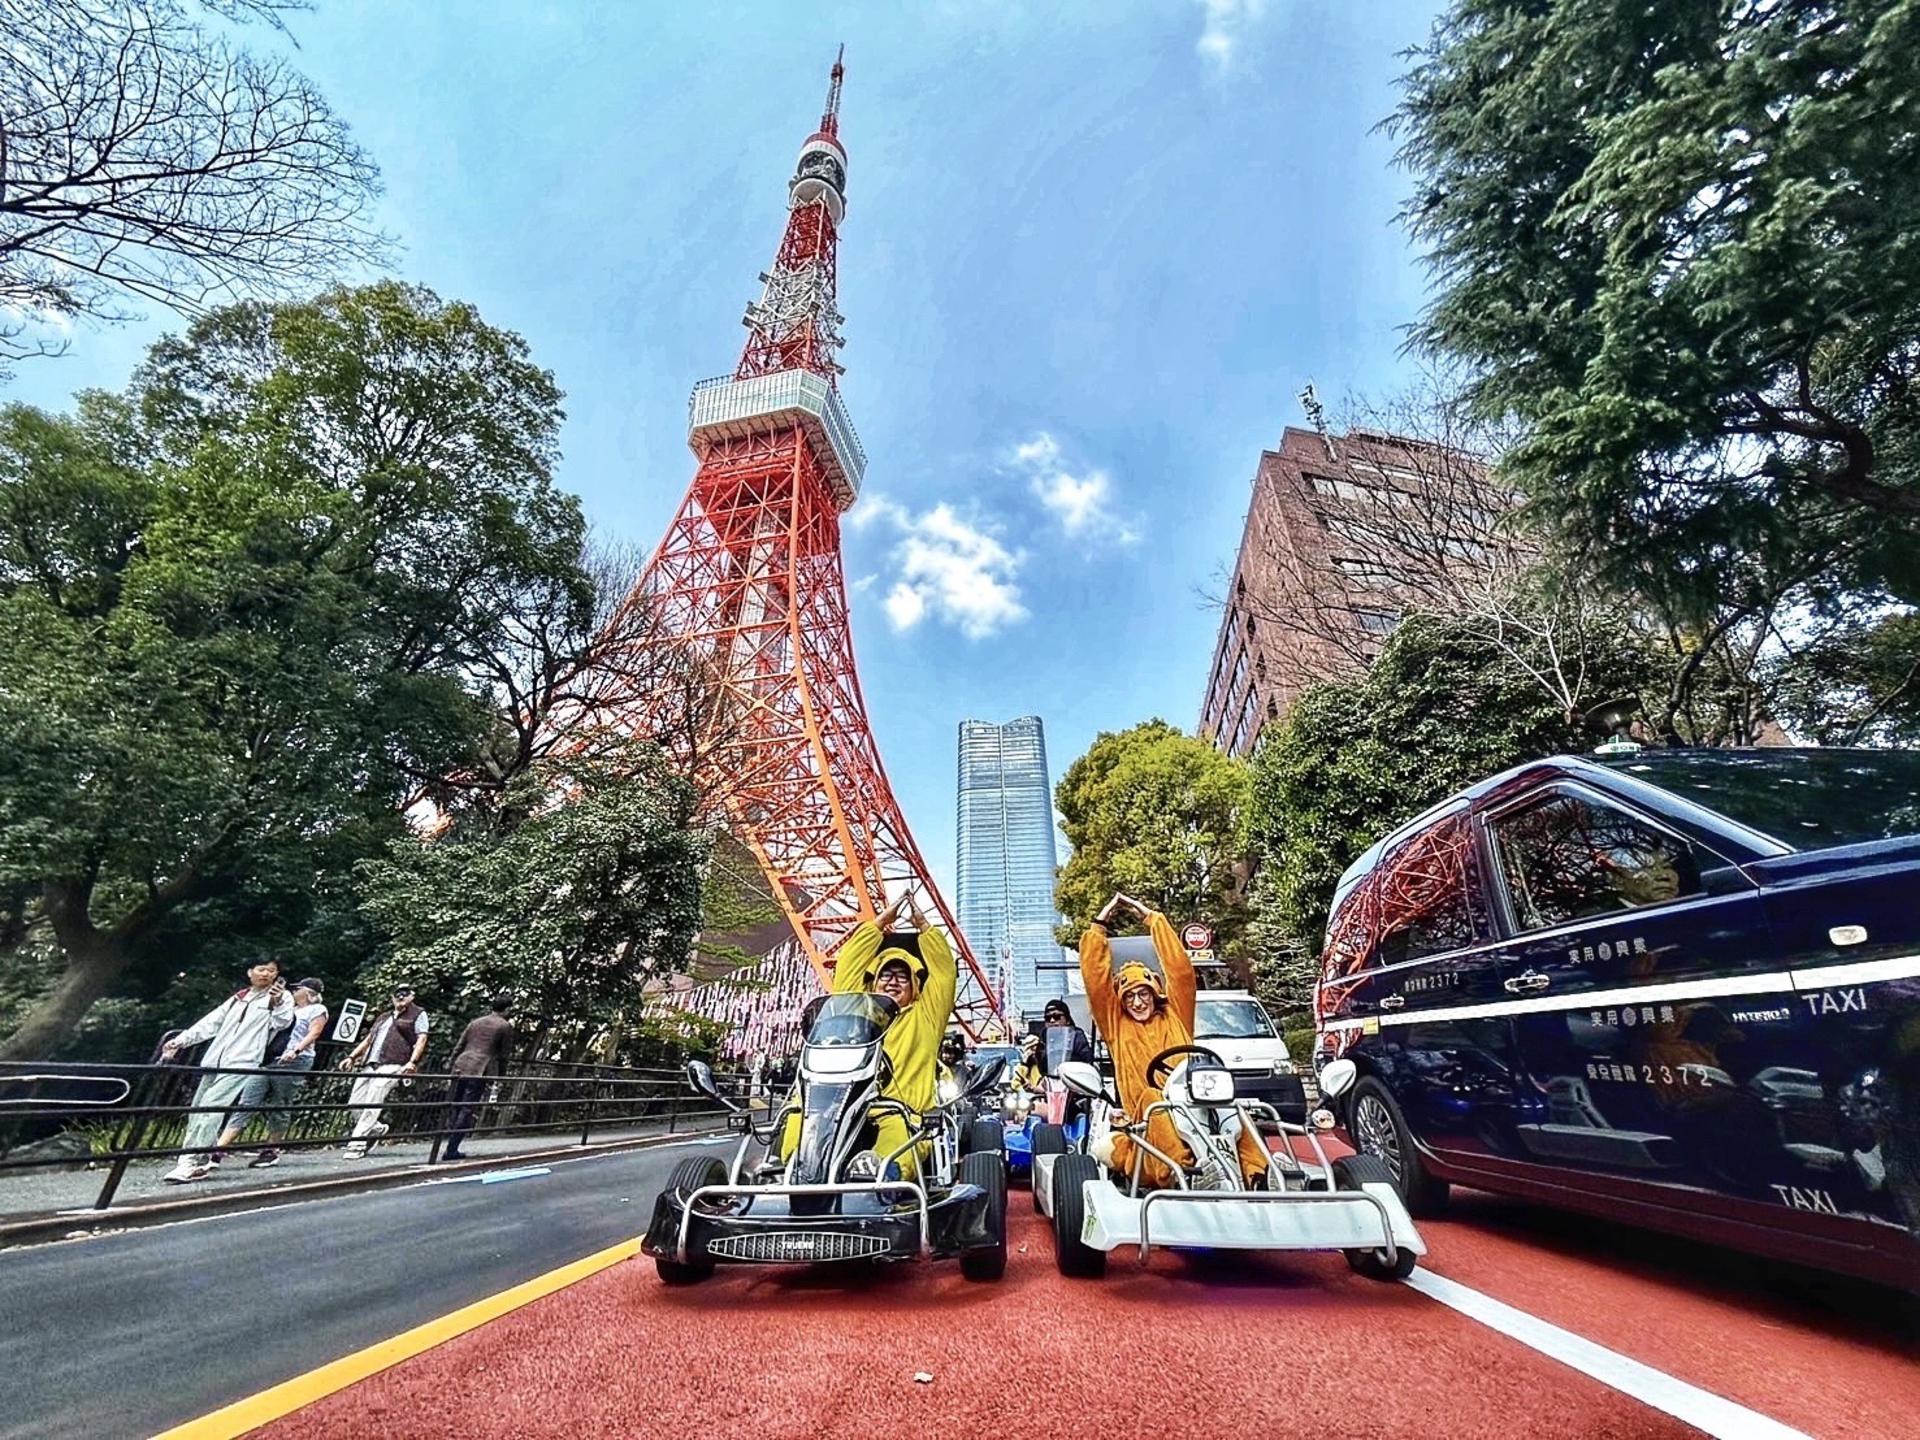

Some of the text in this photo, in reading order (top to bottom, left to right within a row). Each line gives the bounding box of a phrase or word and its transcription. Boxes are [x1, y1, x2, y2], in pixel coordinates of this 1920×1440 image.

[1801, 988, 1867, 1015] TAXI
[1642, 1065, 1713, 1087] 2372
[1768, 1183, 1838, 1215] TAXI
